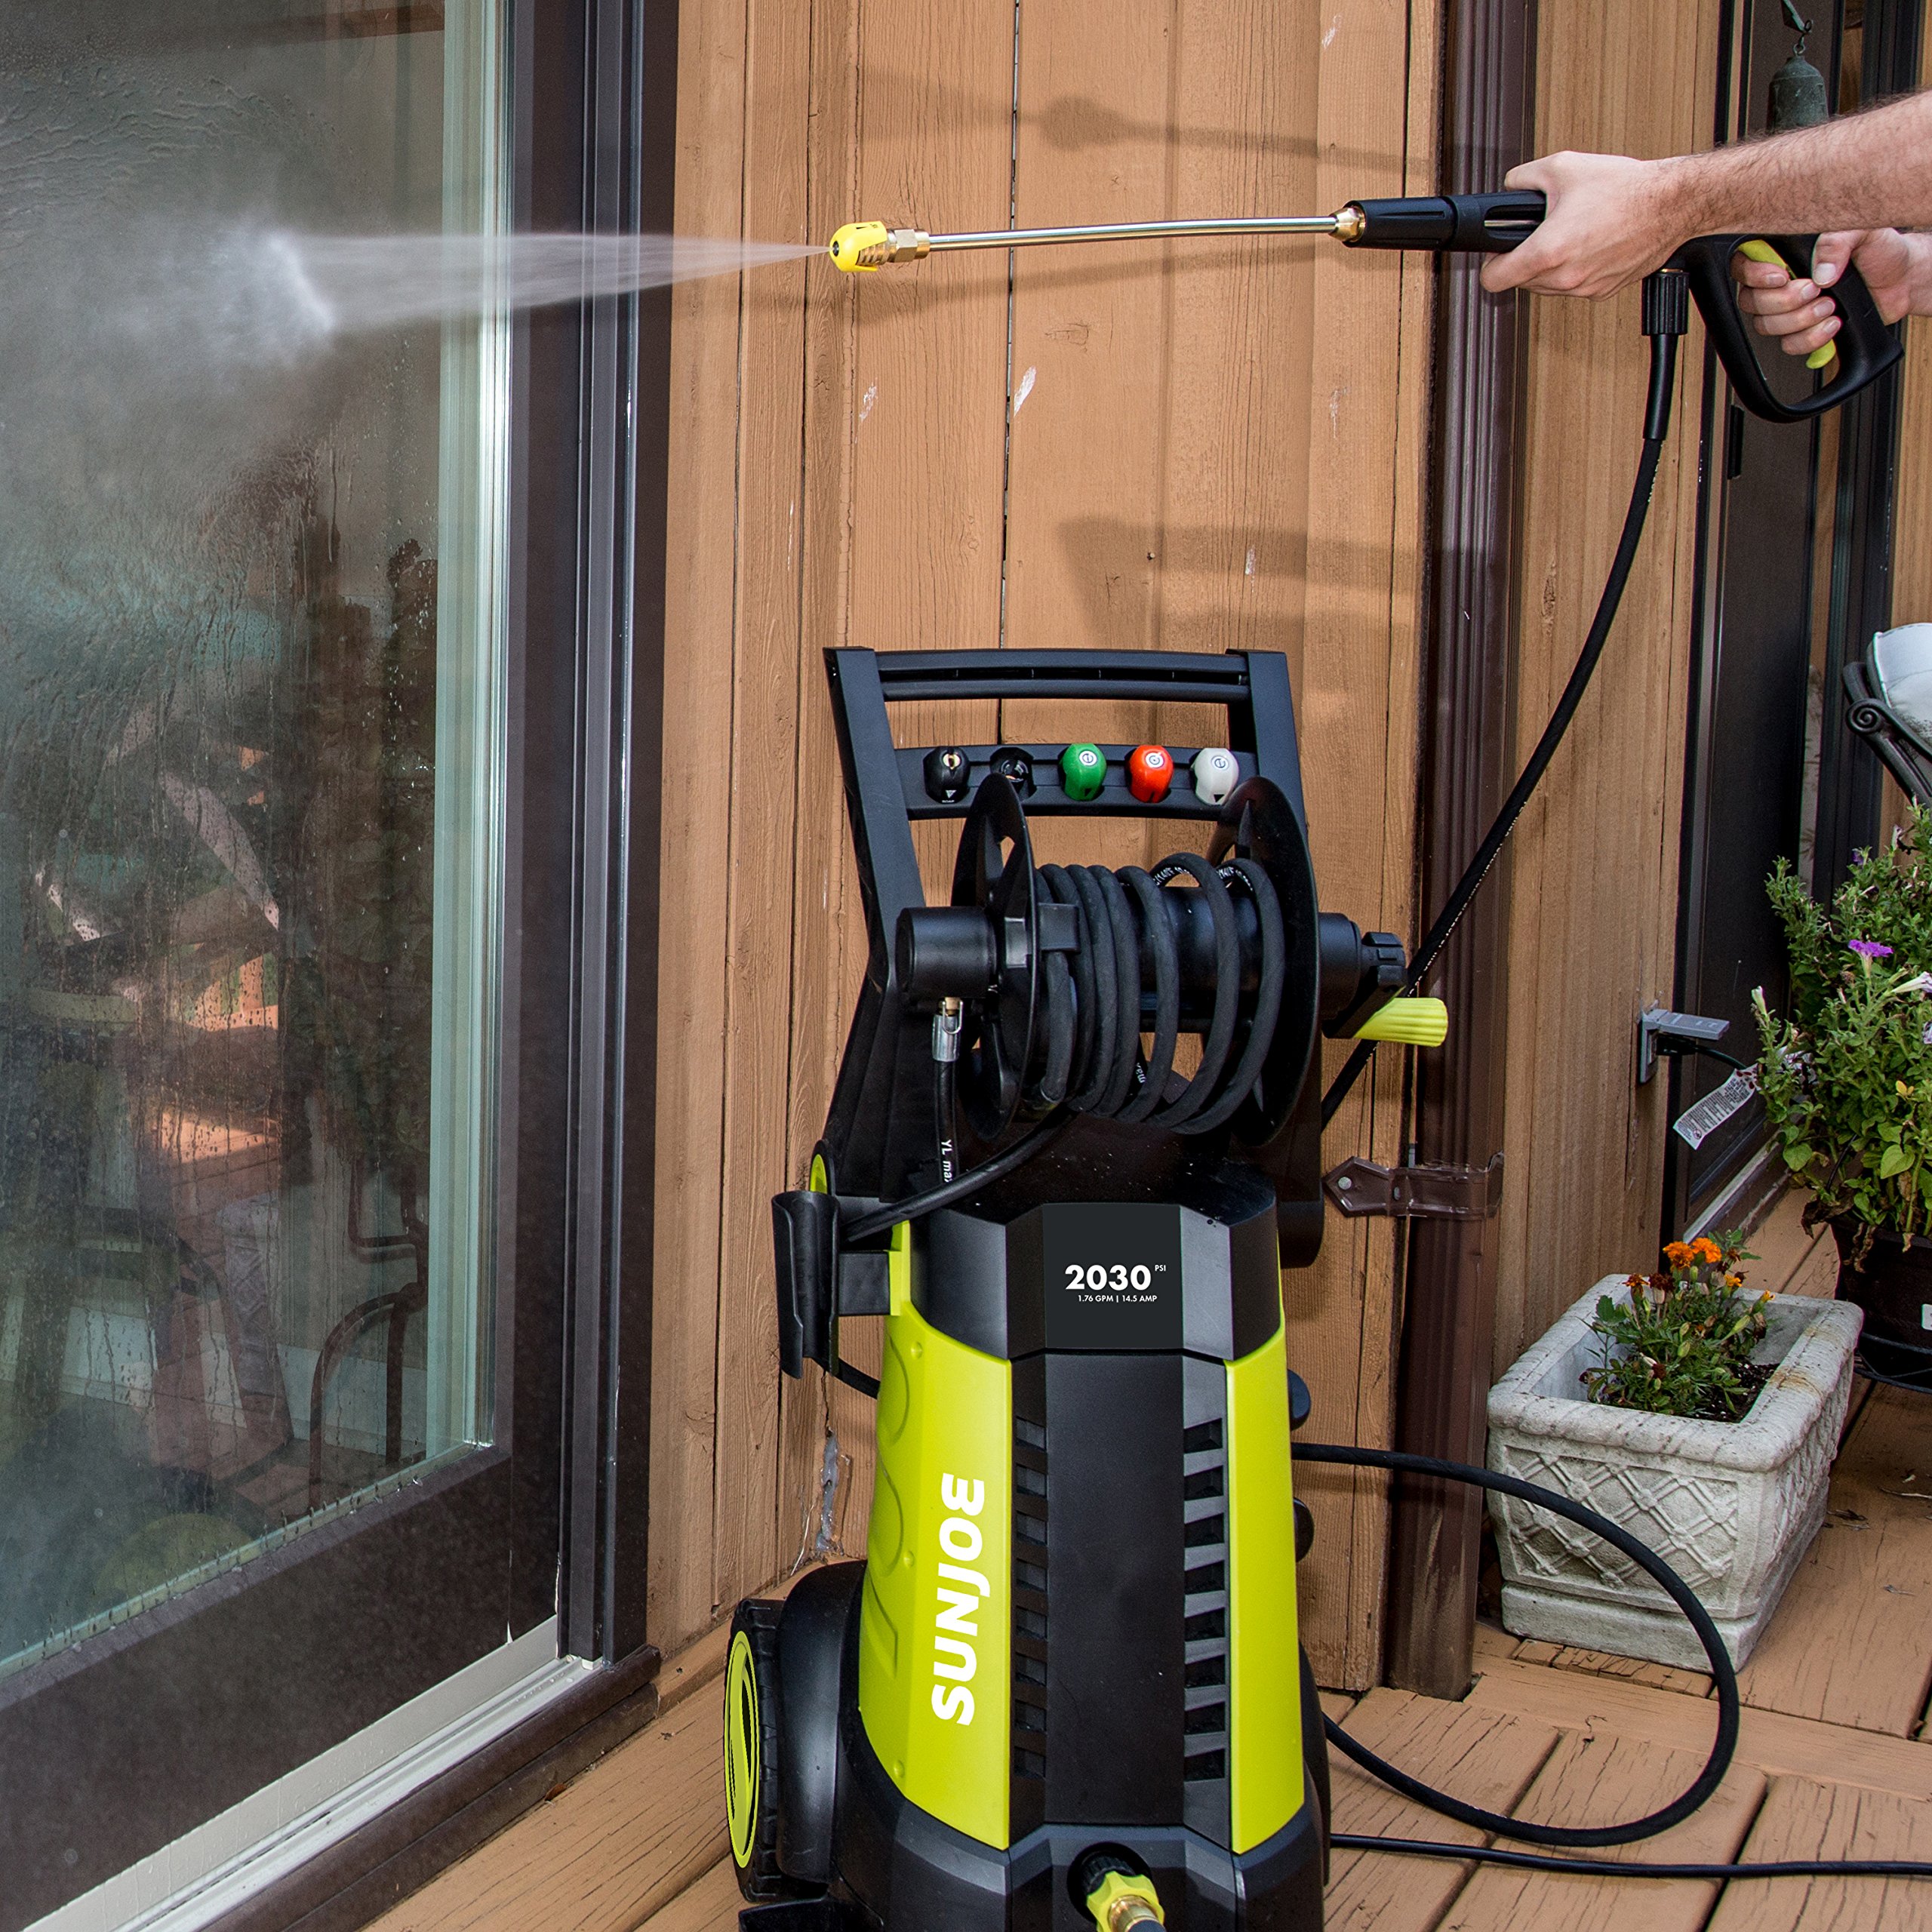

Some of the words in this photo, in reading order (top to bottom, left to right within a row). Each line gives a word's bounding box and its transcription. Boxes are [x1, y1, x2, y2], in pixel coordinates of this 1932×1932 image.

[940, 1139, 953, 1155] YL
[1065, 1264, 1152, 1291] 2030
[1078, 1294, 1094, 1303] 1.76
[1094, 1294, 1114, 1303] GPM
[1121, 1294, 1138, 1303] 14.5
[1139, 1294, 1158, 1303] AMP
[932, 1473, 989, 1724] SUNJOE
